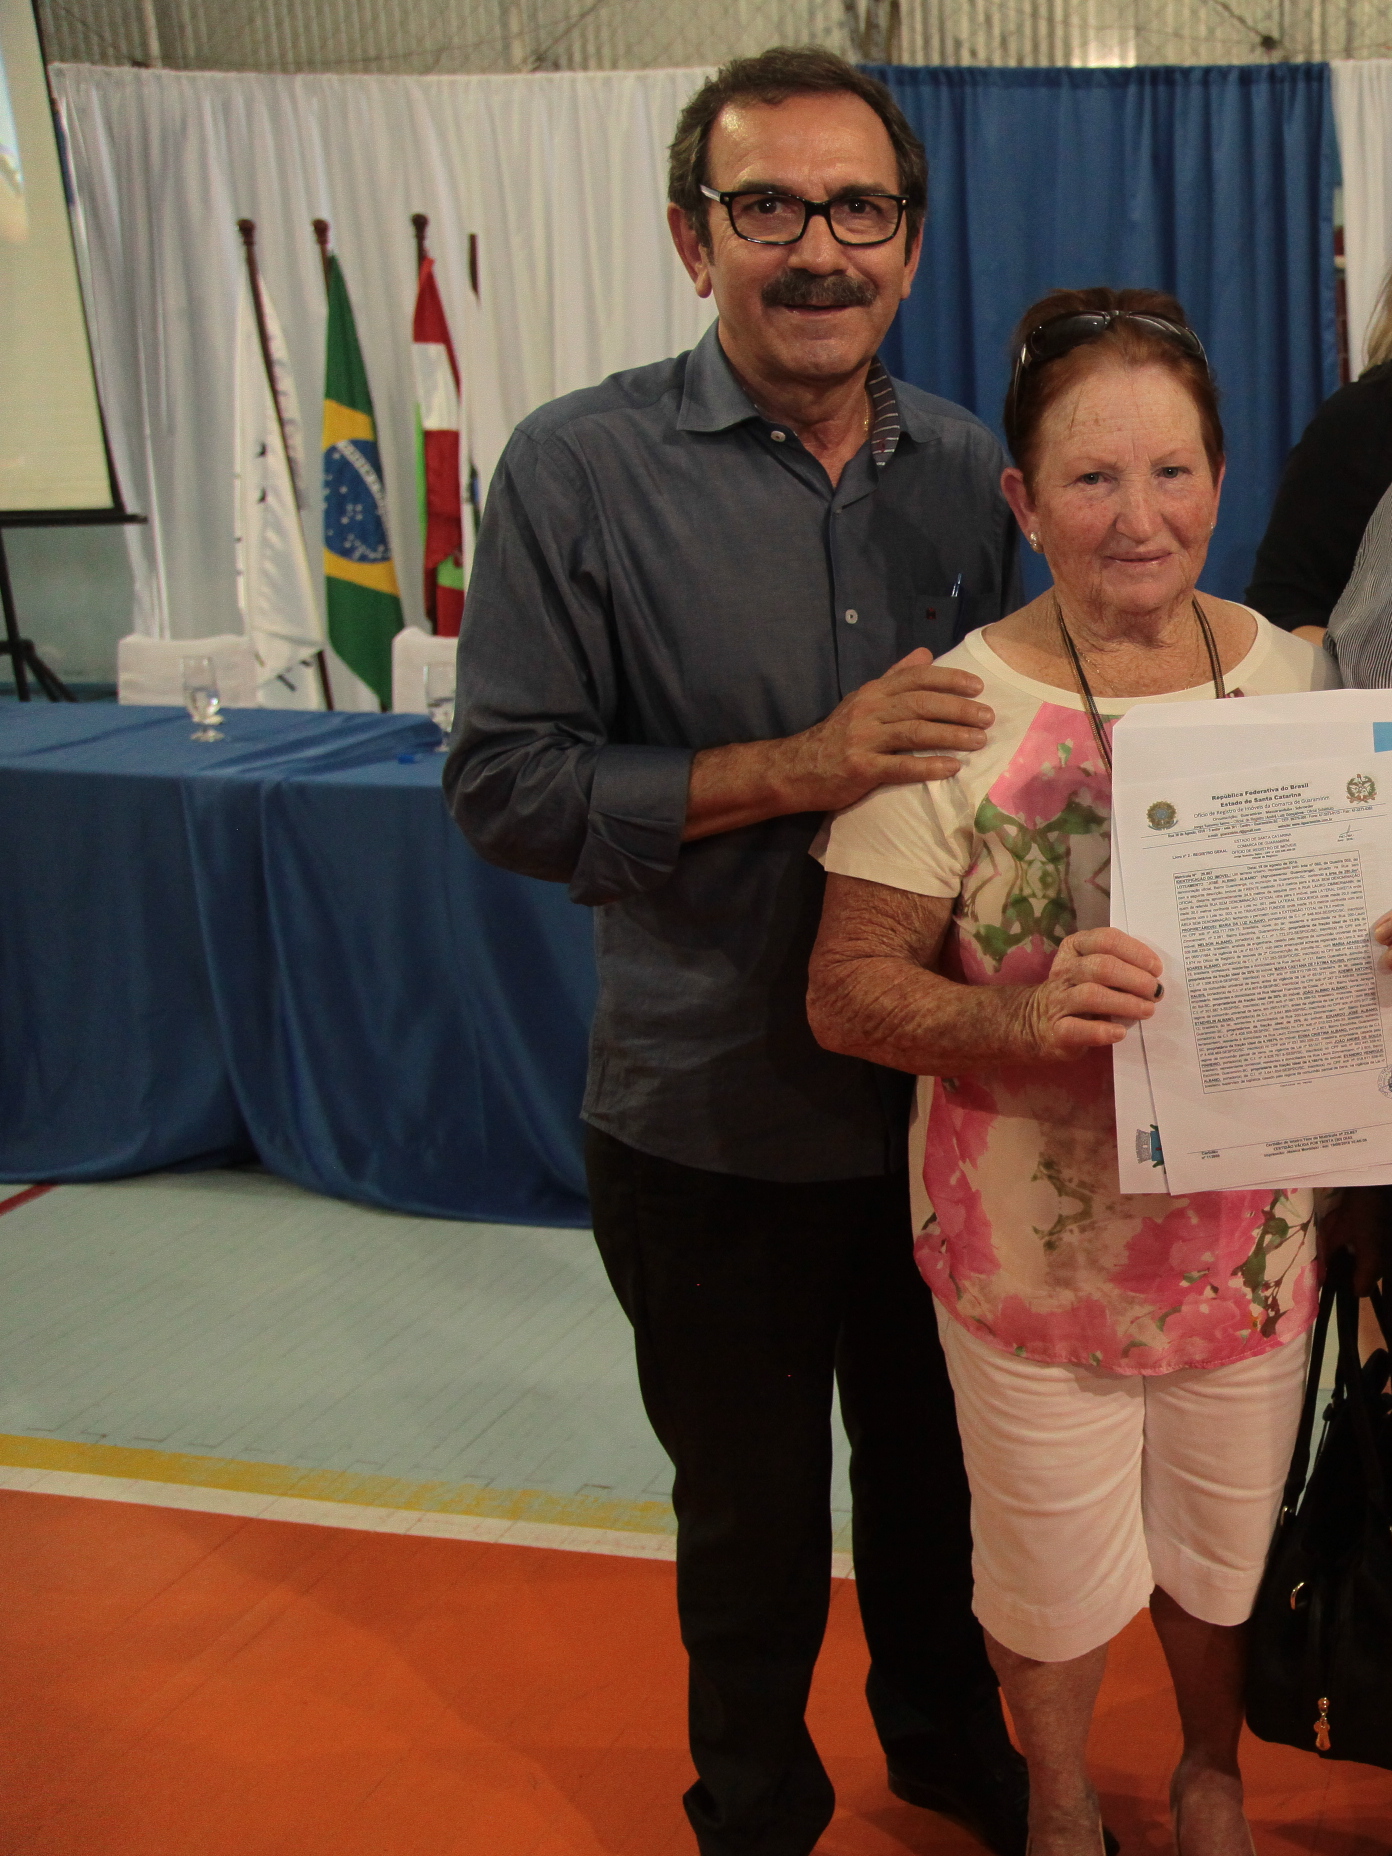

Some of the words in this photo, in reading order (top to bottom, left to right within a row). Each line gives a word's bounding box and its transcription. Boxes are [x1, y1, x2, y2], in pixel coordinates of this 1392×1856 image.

[1212, 792, 1243, 801] República
[1245, 787, 1279, 796] Federativa
[1274, 792, 1301, 800] Catarina
